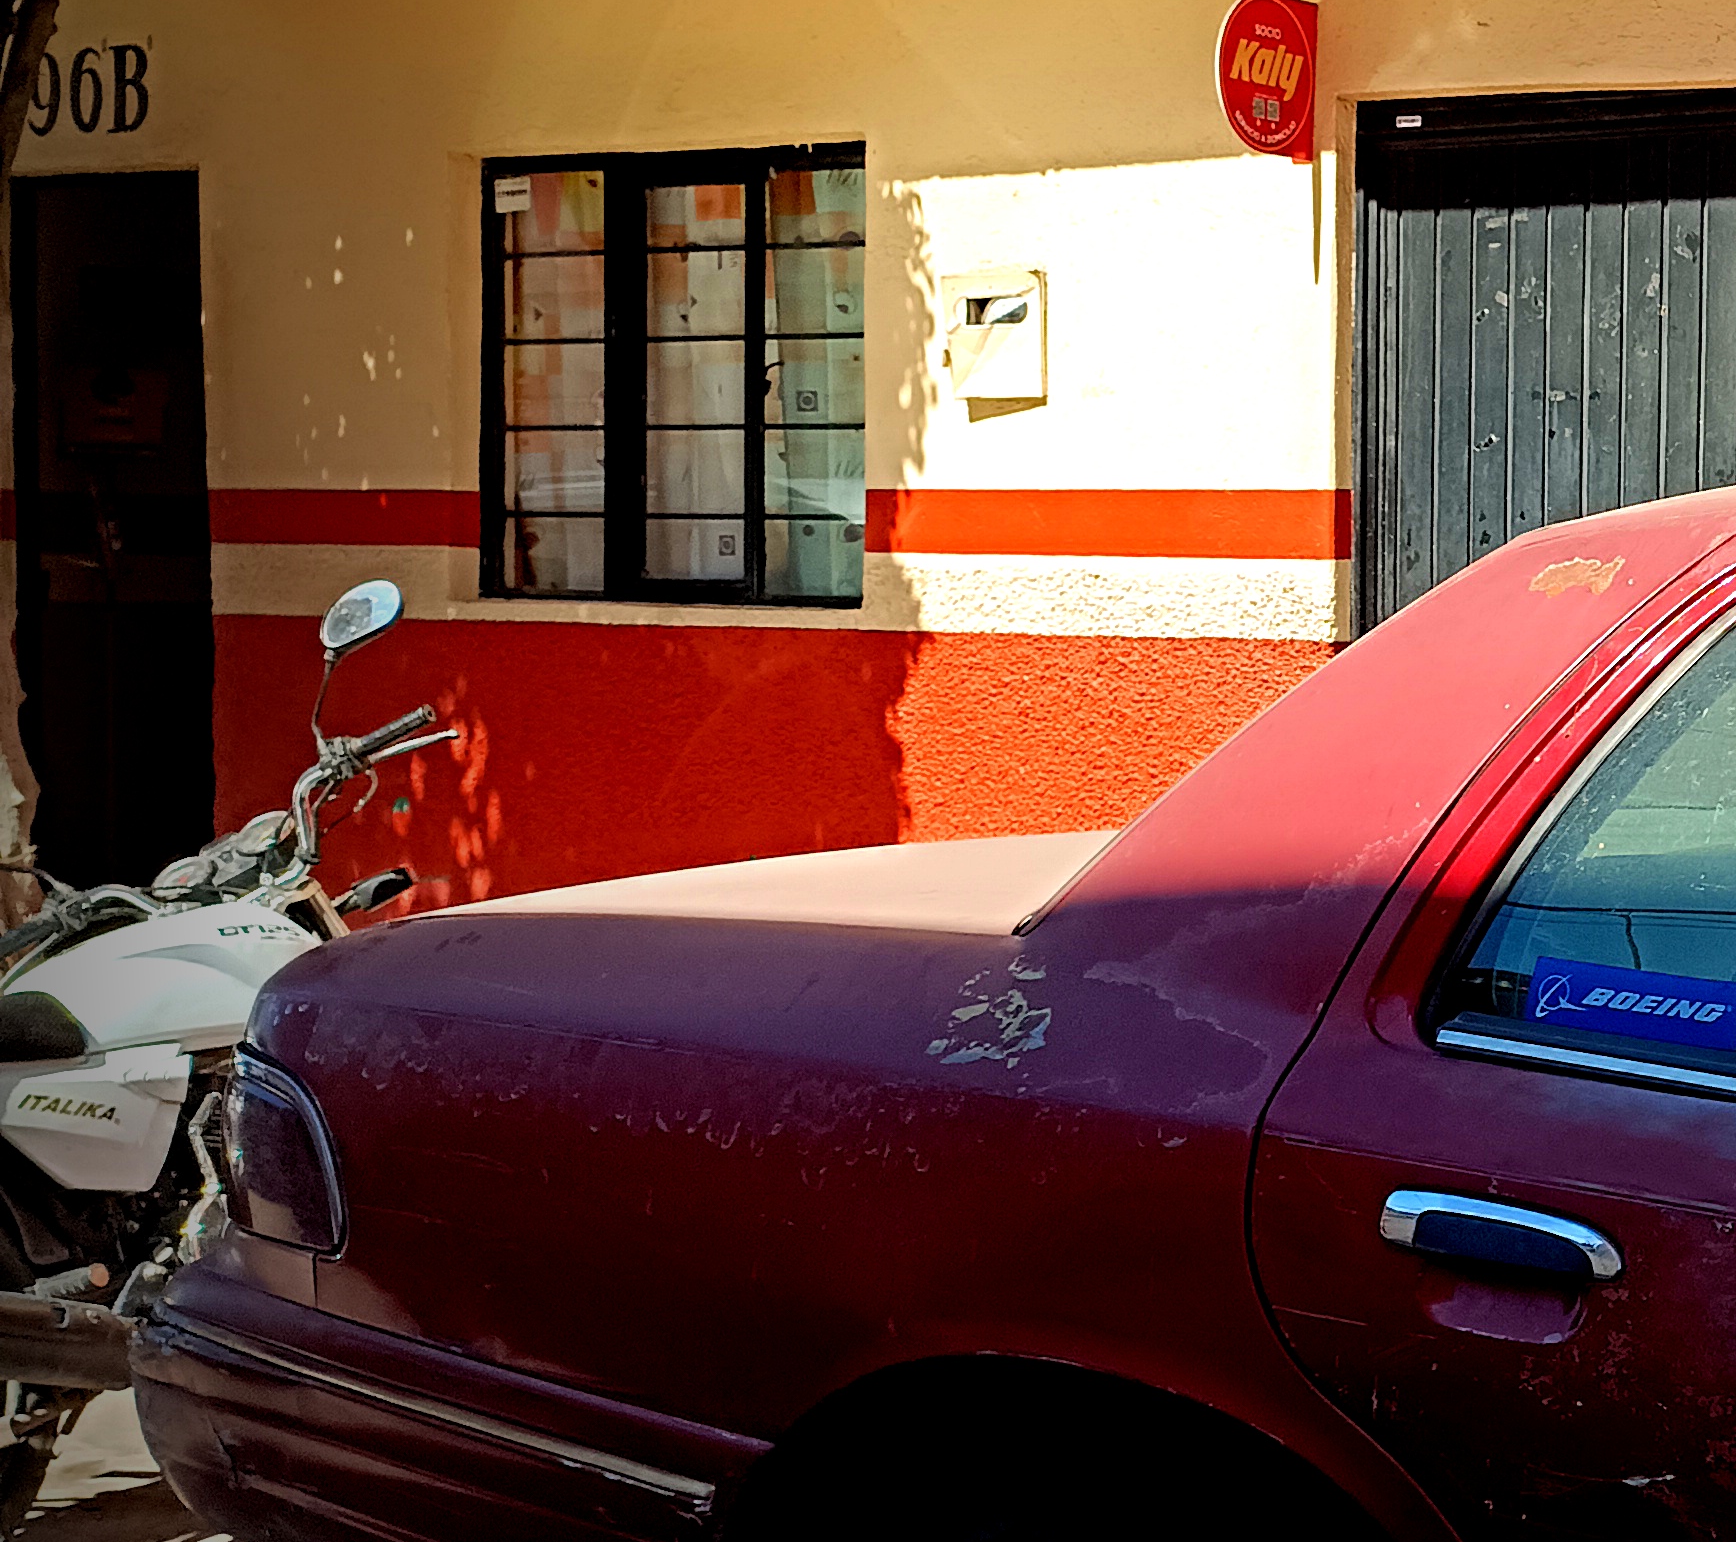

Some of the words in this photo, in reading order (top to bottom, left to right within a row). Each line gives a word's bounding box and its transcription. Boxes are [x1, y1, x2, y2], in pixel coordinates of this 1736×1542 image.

[1255, 24, 1281, 39] SOCIO
[1230, 38, 1304, 101] Kaly
[1581, 987, 1727, 1023] BOEING
[17, 1093, 117, 1121] ITALIKA
